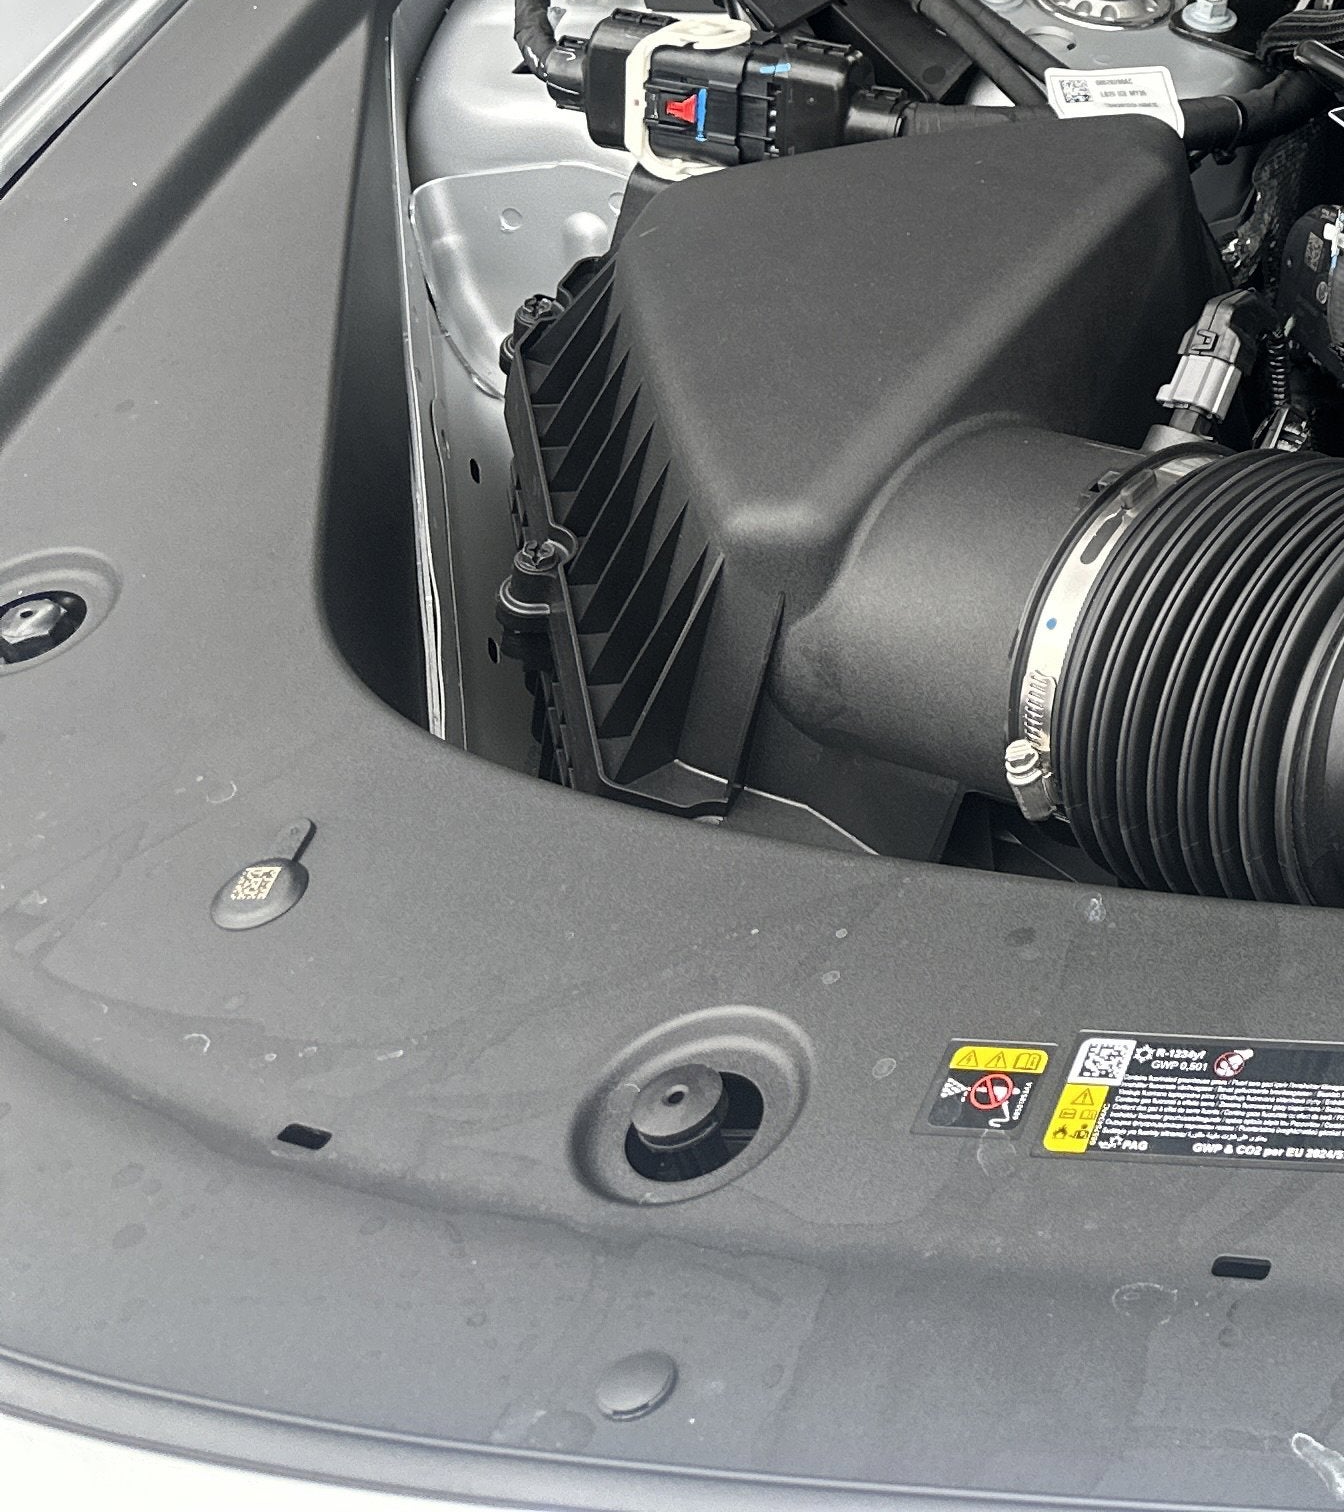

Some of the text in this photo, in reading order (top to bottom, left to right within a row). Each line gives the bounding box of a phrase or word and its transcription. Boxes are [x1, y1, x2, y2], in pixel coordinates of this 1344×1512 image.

[1155, 1048, 1207, 1061] R-1234yf
[1151, 1060, 1178, 1070] GWP
[1122, 1140, 1148, 1151] PAG
[1192, 1142, 1224, 1153] GWP
[1236, 1145, 1262, 1156] CO2
[1263, 1147, 1285, 1159] per
[1286, 1147, 1304, 1158] EU
